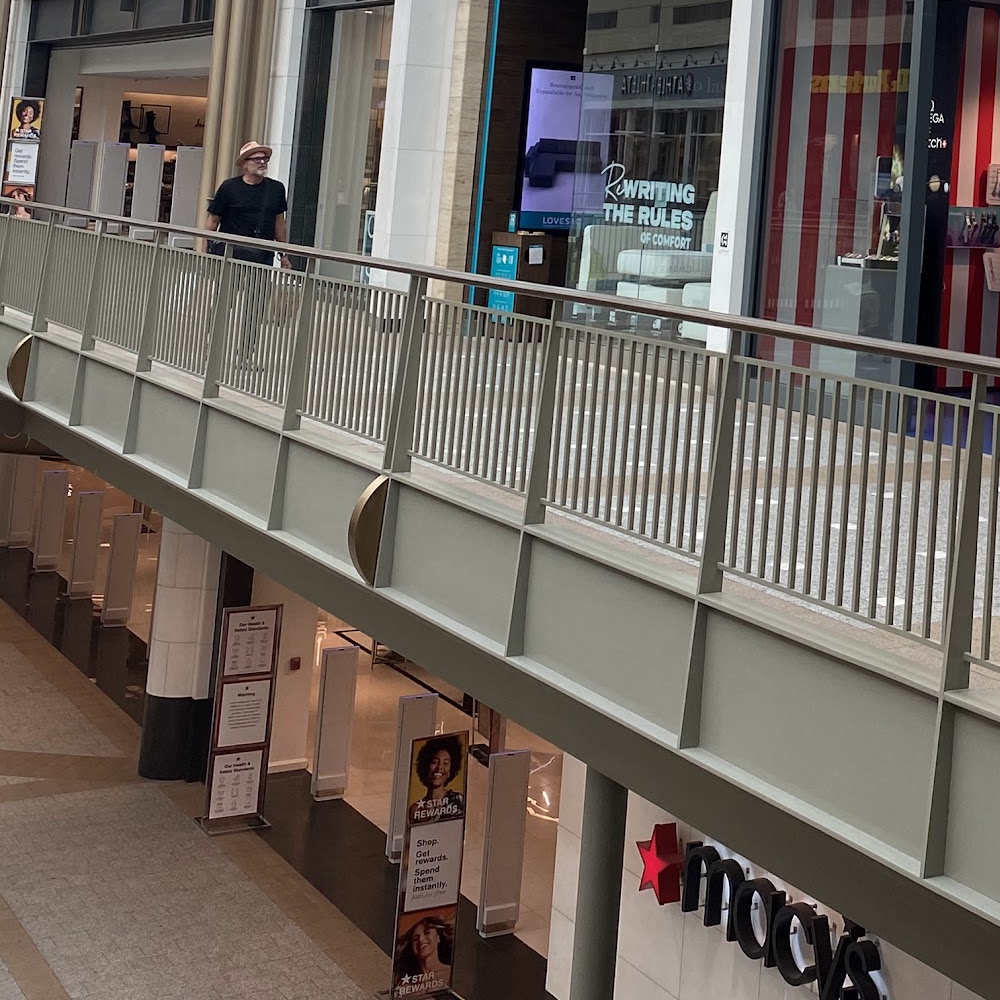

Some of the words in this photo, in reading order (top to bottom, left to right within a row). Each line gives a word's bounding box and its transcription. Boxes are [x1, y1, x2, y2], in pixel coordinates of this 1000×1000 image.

[603, 203, 635, 224] THE
[638, 206, 694, 231] RULES
[640, 232, 651, 244] OF
[652, 234, 692, 250] COMFORT
[426, 797, 449, 808] STAR
[414, 805, 458, 819] REWARDS
[416, 839, 438, 847] Shop.
[415, 850, 430, 858] Get
[415, 854, 448, 865] rewards.
[414, 865, 440, 877] Spend
[414, 875, 433, 884] them
[413, 881, 447, 893] instantly.
[412, 972, 435, 983] STAR
[398, 979, 444, 996] REWARDS
